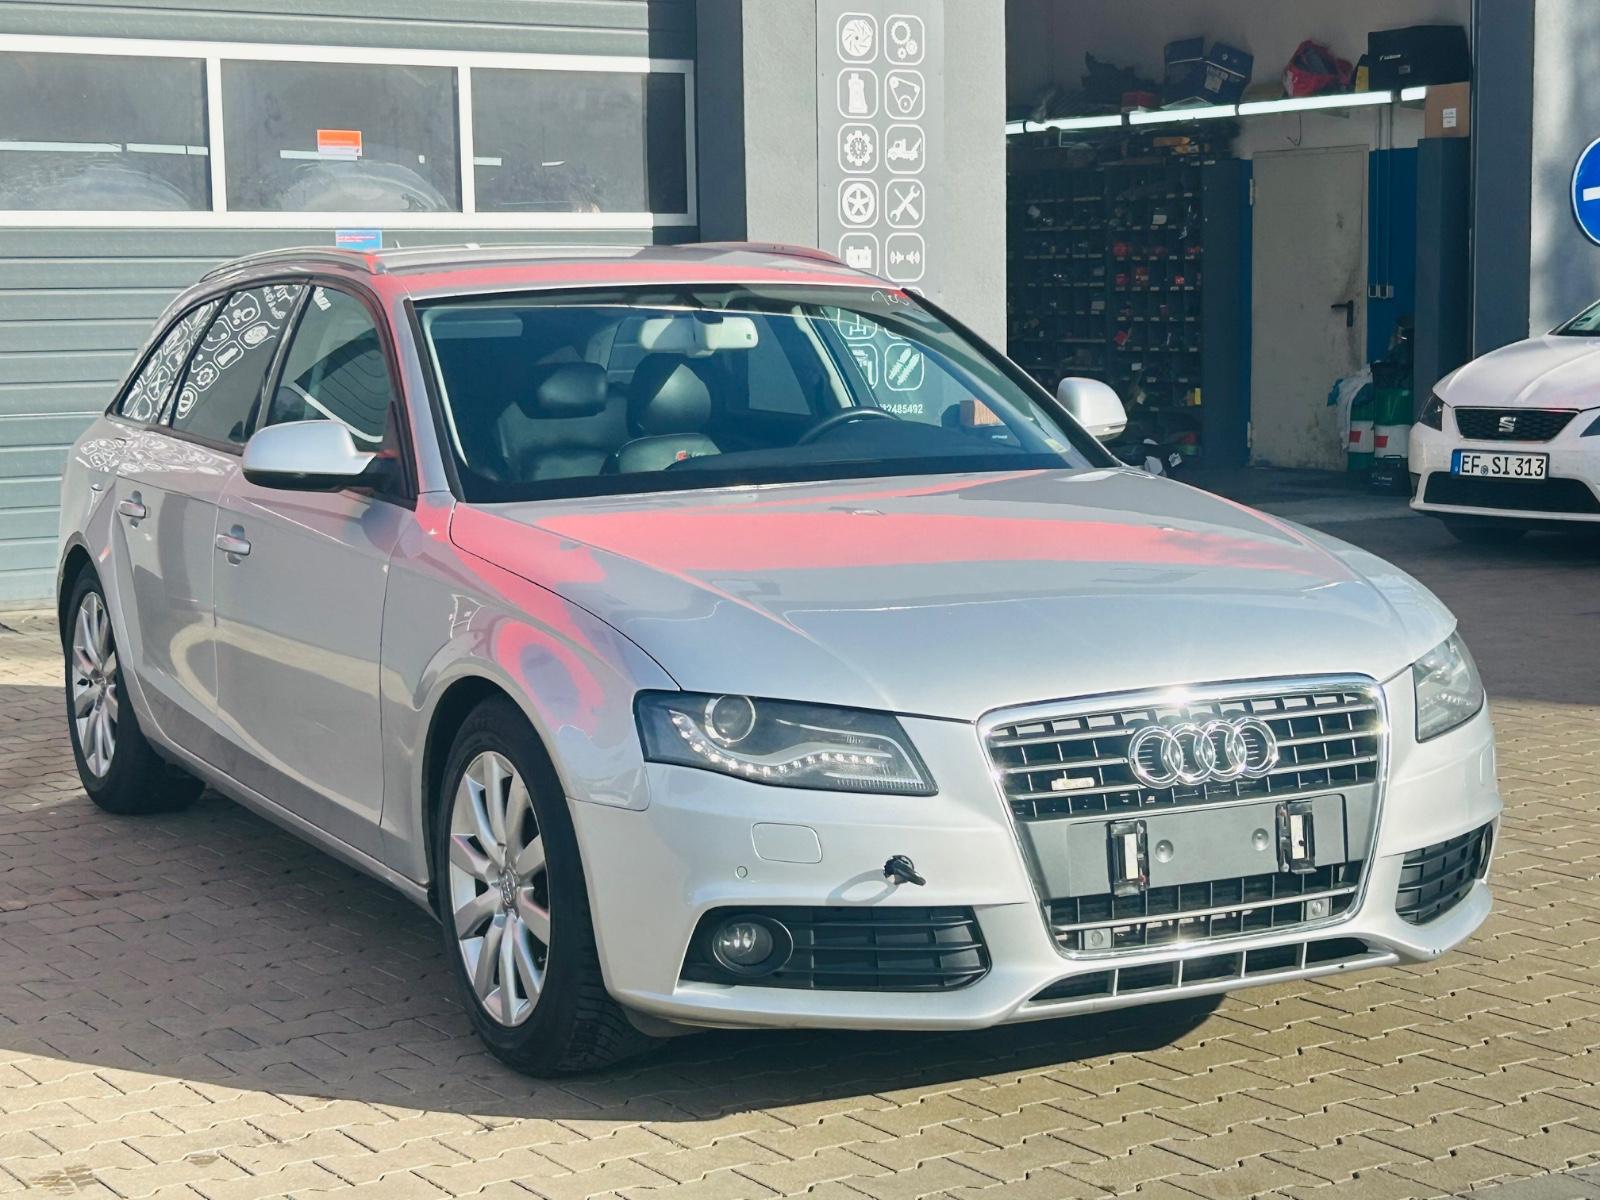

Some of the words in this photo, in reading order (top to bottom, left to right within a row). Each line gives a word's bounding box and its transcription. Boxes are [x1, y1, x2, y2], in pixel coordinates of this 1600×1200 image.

[1461, 455, 1482, 474] EF
[1491, 456, 1510, 475] SI
[1514, 458, 1545, 477] 313
